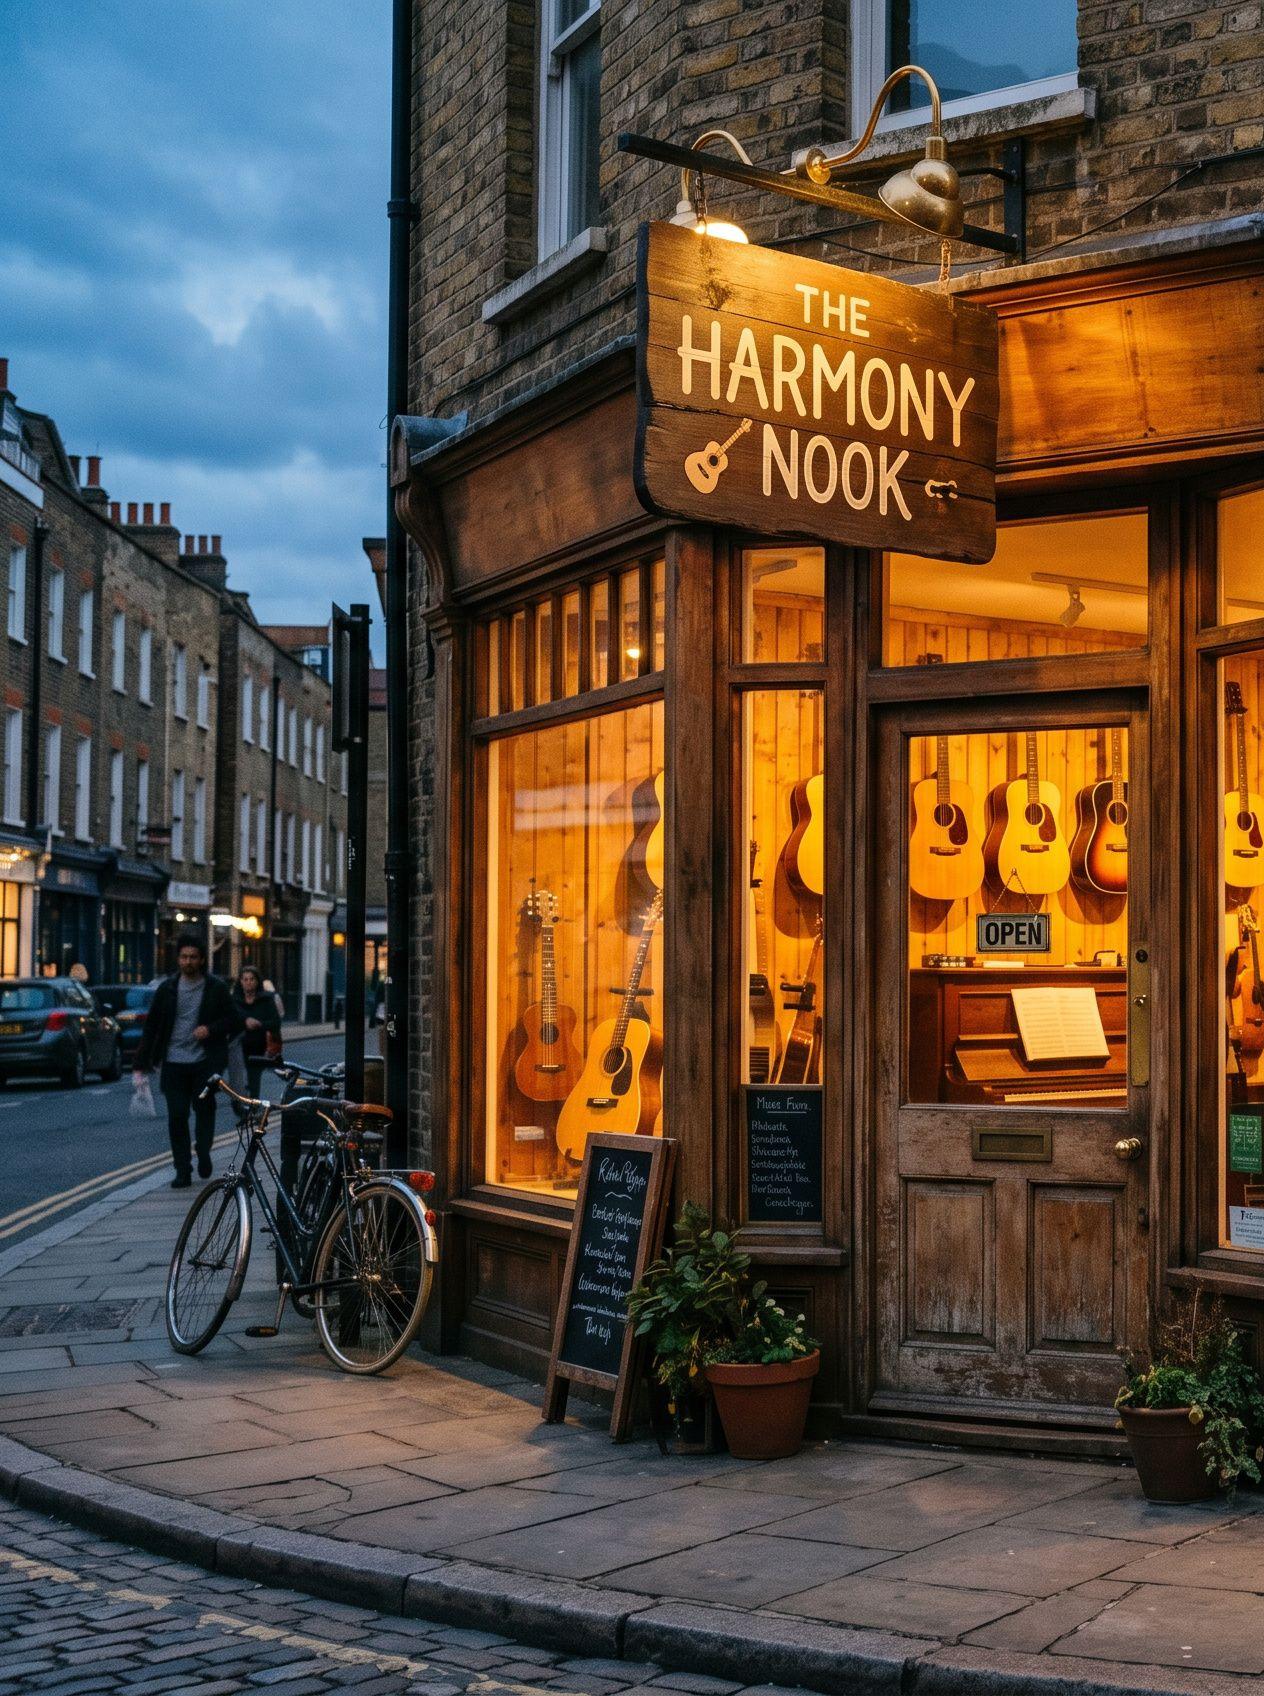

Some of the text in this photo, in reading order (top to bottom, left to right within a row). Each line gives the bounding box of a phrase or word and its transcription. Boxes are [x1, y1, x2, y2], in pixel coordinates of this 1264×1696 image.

[795, 283, 870, 338] THE
[677, 315, 975, 447] HARMONY
[762, 423, 912, 521] NOOK
[985, 921, 1042, 946] OPEN
